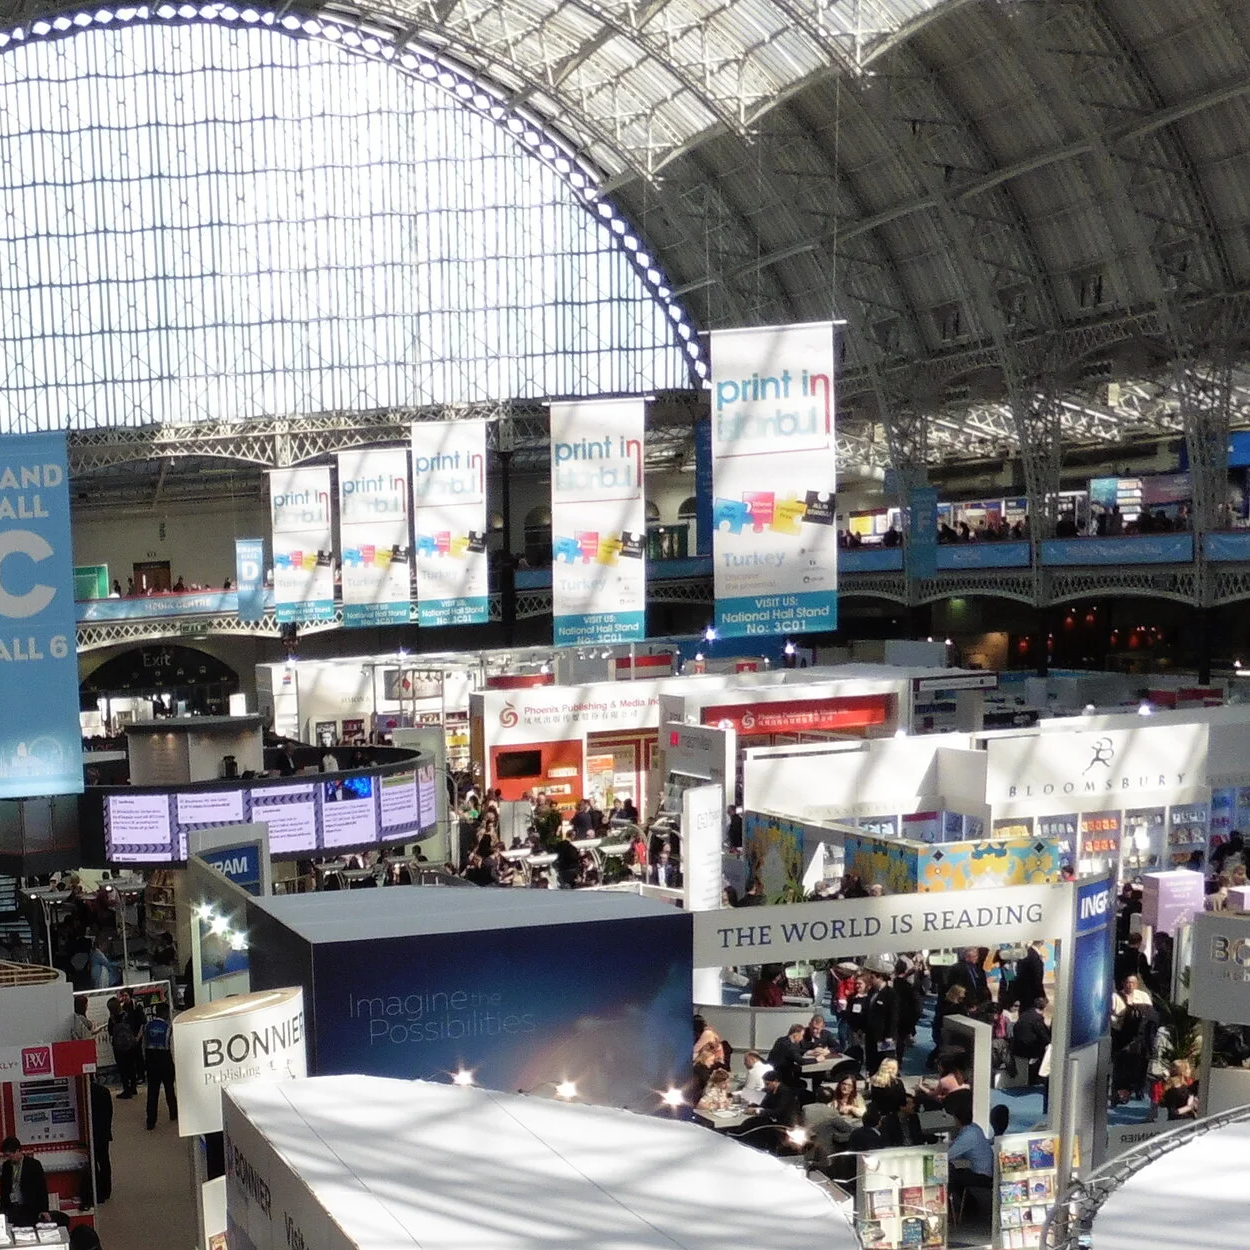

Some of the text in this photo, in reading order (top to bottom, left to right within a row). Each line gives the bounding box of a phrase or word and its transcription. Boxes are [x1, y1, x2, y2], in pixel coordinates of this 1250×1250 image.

[716, 370, 792, 411] print
[718, 407, 817, 442] istanbul
[555, 436, 612, 467] print
[416, 451, 460, 476] print
[342, 476, 384, 495] print
[274, 491, 314, 507] print
[723, 551, 786, 568] Turkey
[242, 562, 259, 581] D
[561, 579, 607, 592] Turkey
[422, 609, 450, 617] National
[466, 606, 484, 614] Stand
[755, 597, 798, 608] VISIT US:
[583, 616, 603, 624] VISIT
[722, 606, 830, 623] National Hall Stand
[558, 622, 640, 636] National Hall Stand
[747, 620, 807, 633] No: 3C01
[50, 635, 68, 659] 6
[143, 652, 171, 667] Exit
[524, 705, 559, 715] Phoenix
[562, 702, 607, 713] Publishing
[620, 699, 646, 708] Media
[1009, 772, 1187, 798] BLOOMSBURY
[209, 857, 248, 876] RAM
[717, 903, 1044, 949] THE WORLD IS READING
[350, 989, 467, 1022] Imagine
[369, 1010, 537, 1046] Possibilities
[204, 1064, 261, 1085] Publishing
